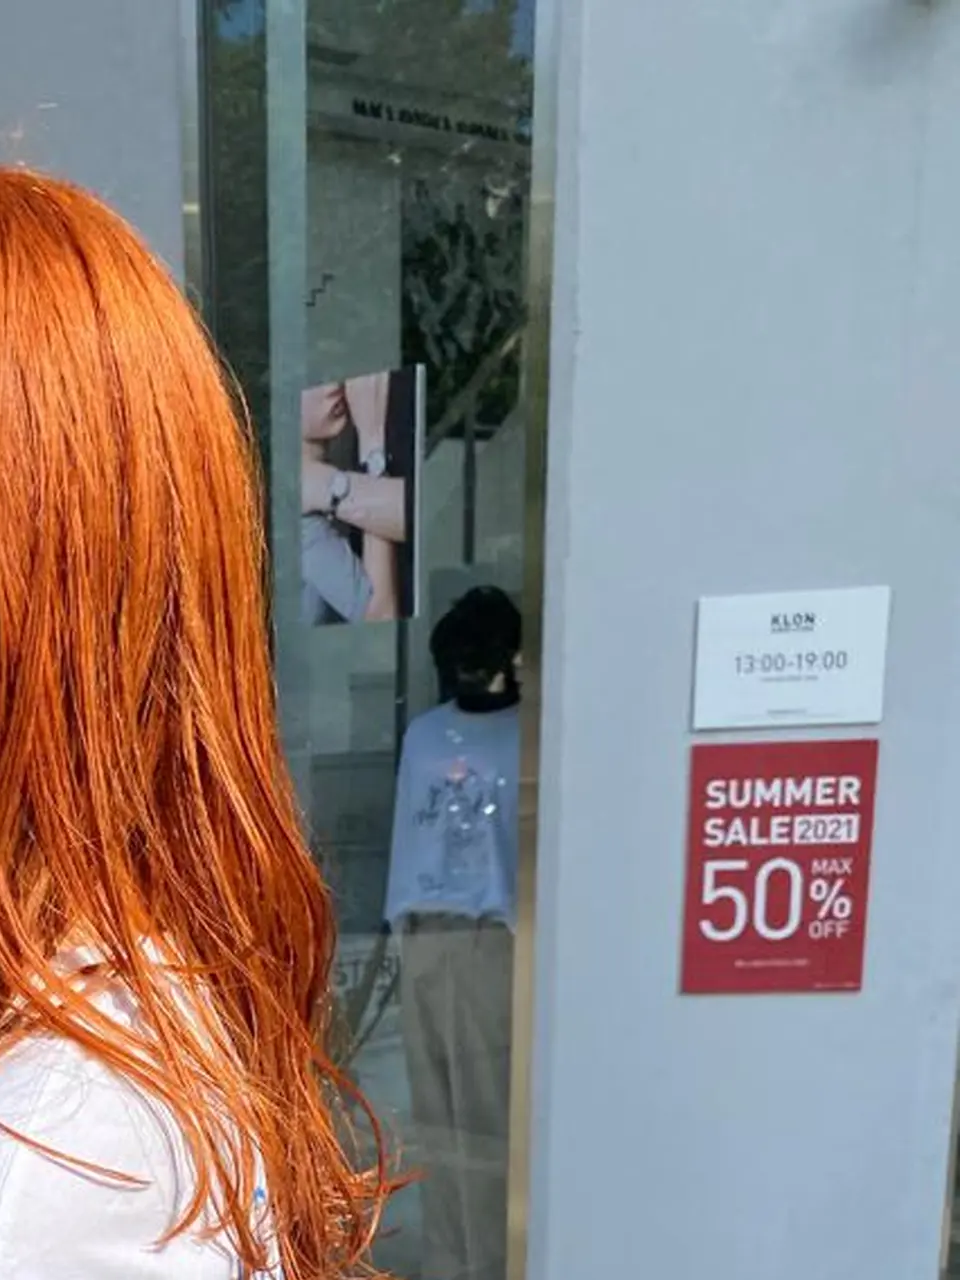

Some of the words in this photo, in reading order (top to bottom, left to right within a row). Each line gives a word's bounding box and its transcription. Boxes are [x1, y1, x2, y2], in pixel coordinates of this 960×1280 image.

[769, 612, 817, 628] KLON
[705, 775, 862, 809] SUMMER
[703, 816, 791, 847] SALE
[797, 817, 855, 842] 2021
[811, 857, 854, 876] MAX
[807, 920, 850, 939] OFF
